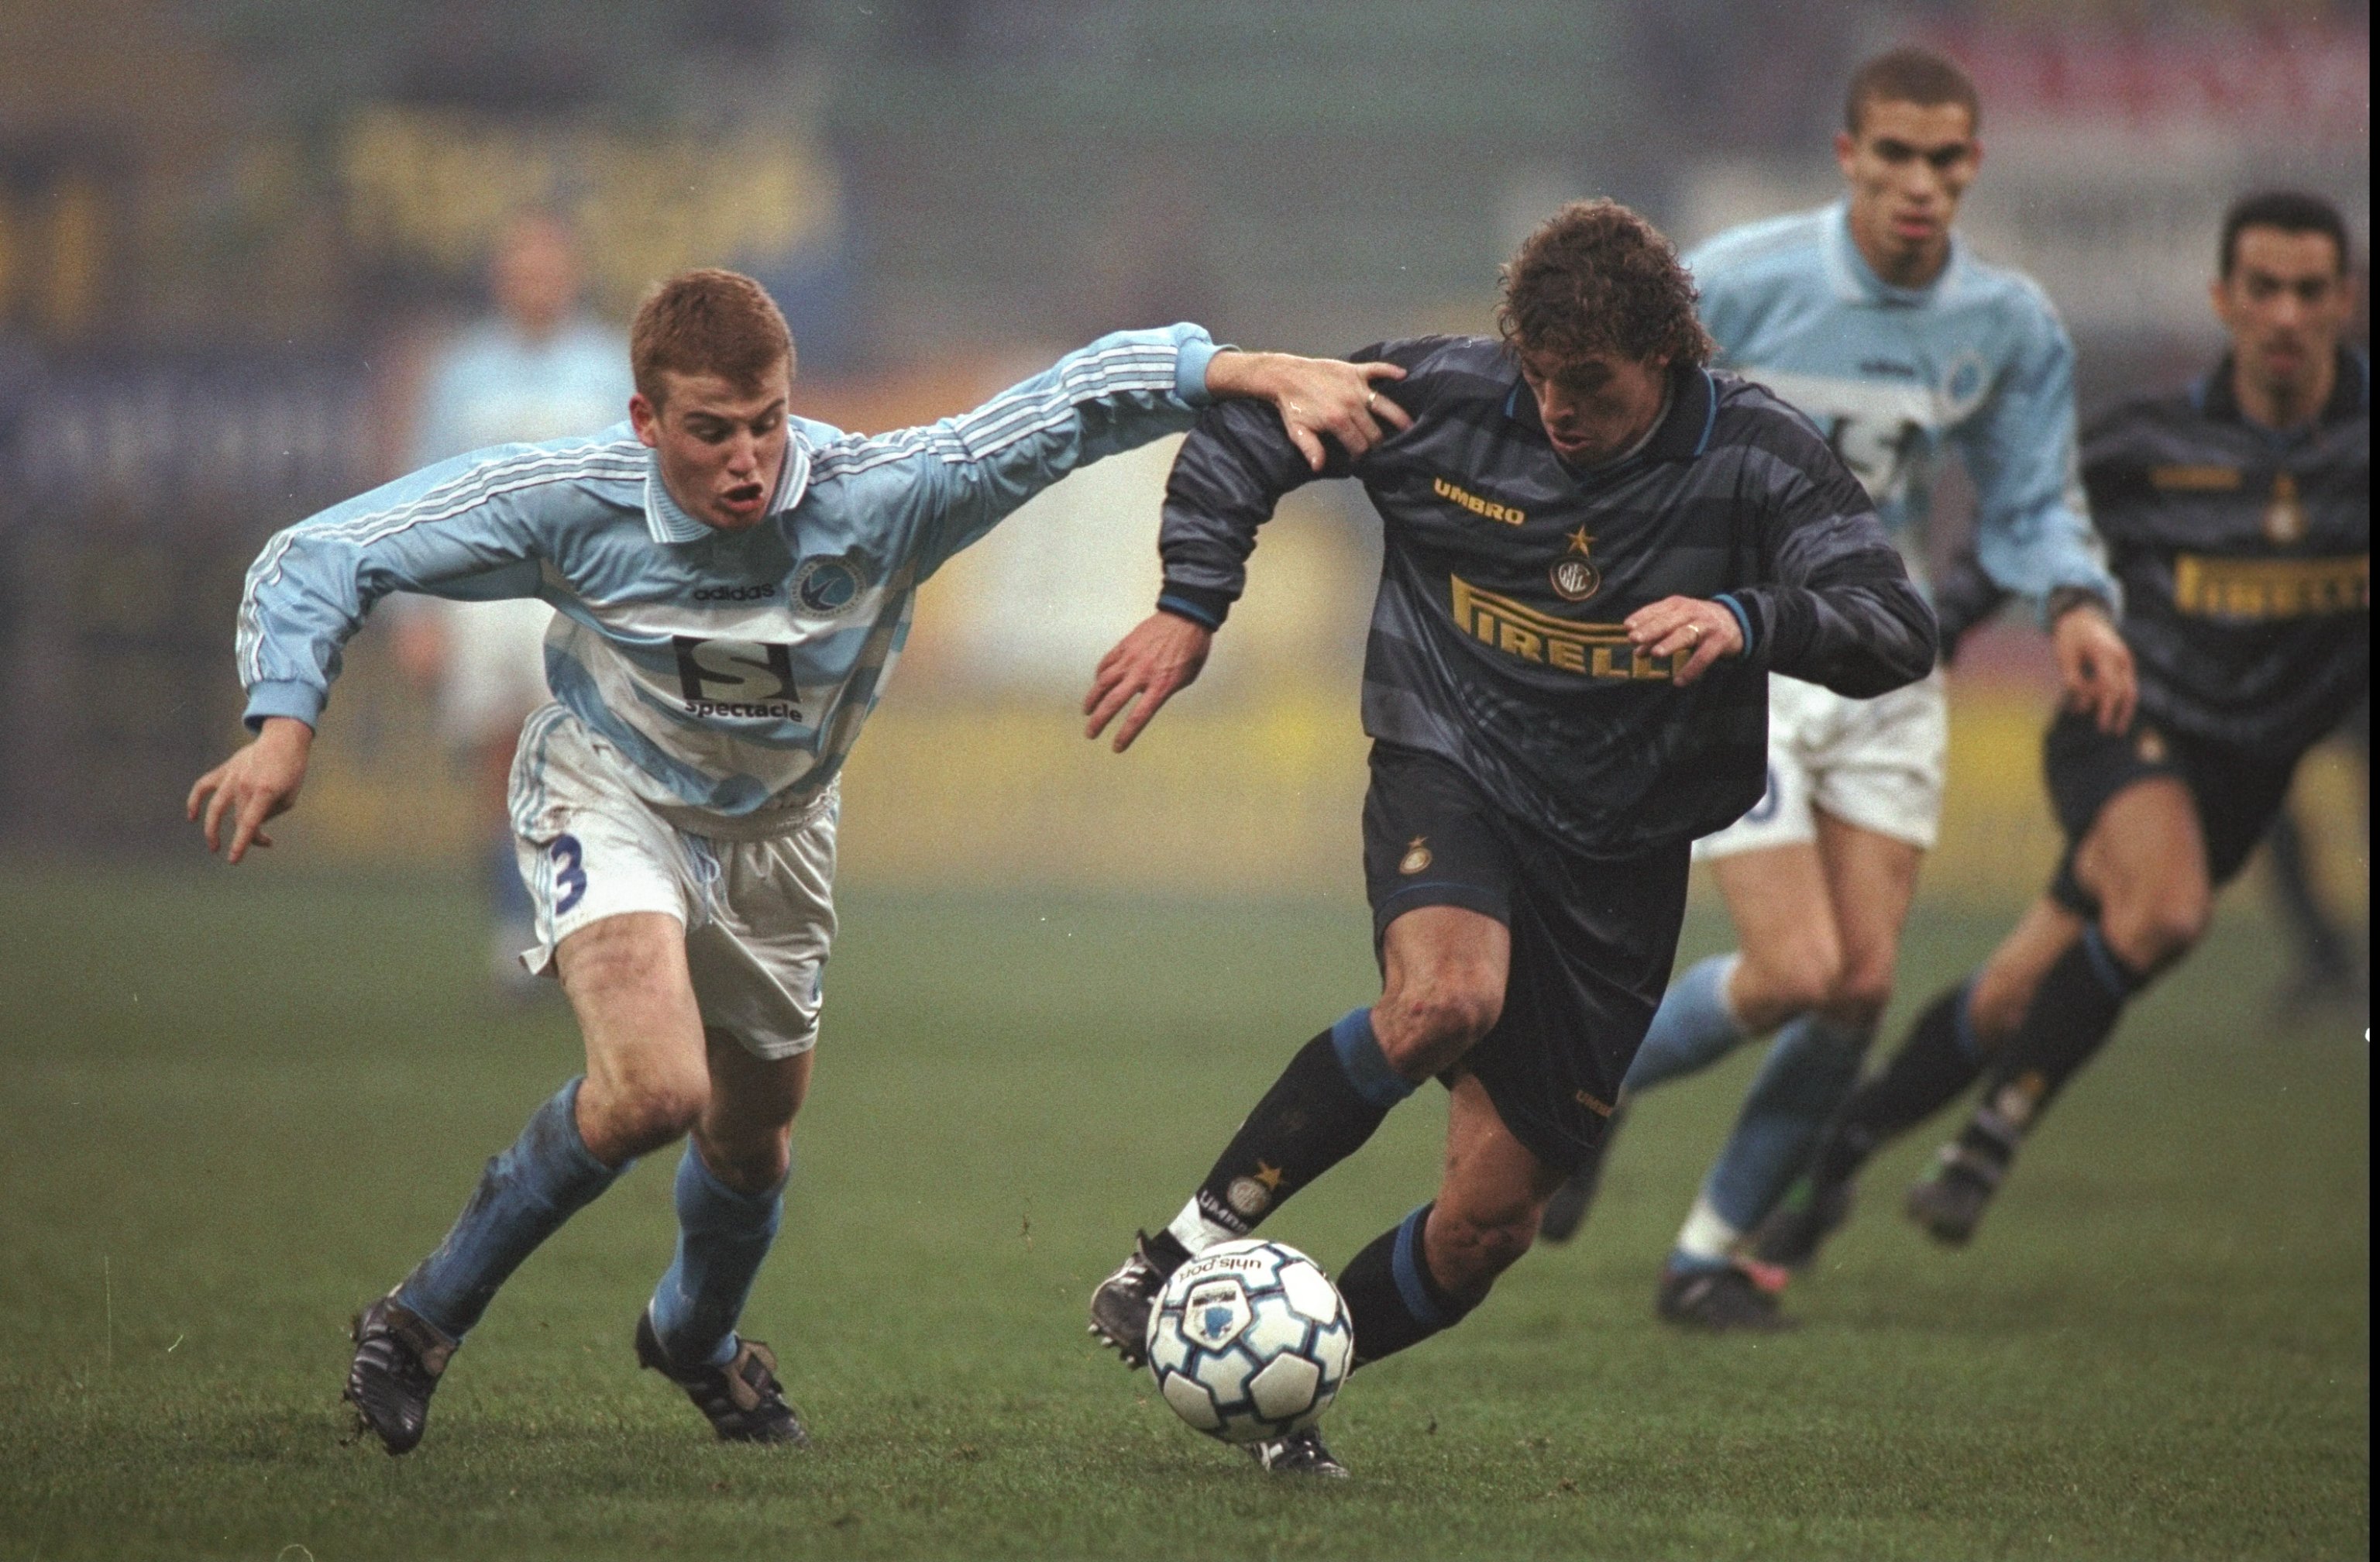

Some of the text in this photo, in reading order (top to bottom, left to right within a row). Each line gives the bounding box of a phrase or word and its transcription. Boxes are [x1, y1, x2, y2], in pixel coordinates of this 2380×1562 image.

[1434, 477, 1525, 525] UMBRO
[694, 583, 775, 601] adidas
[685, 701, 803, 723] spectacle
[551, 834, 587, 916] 3
